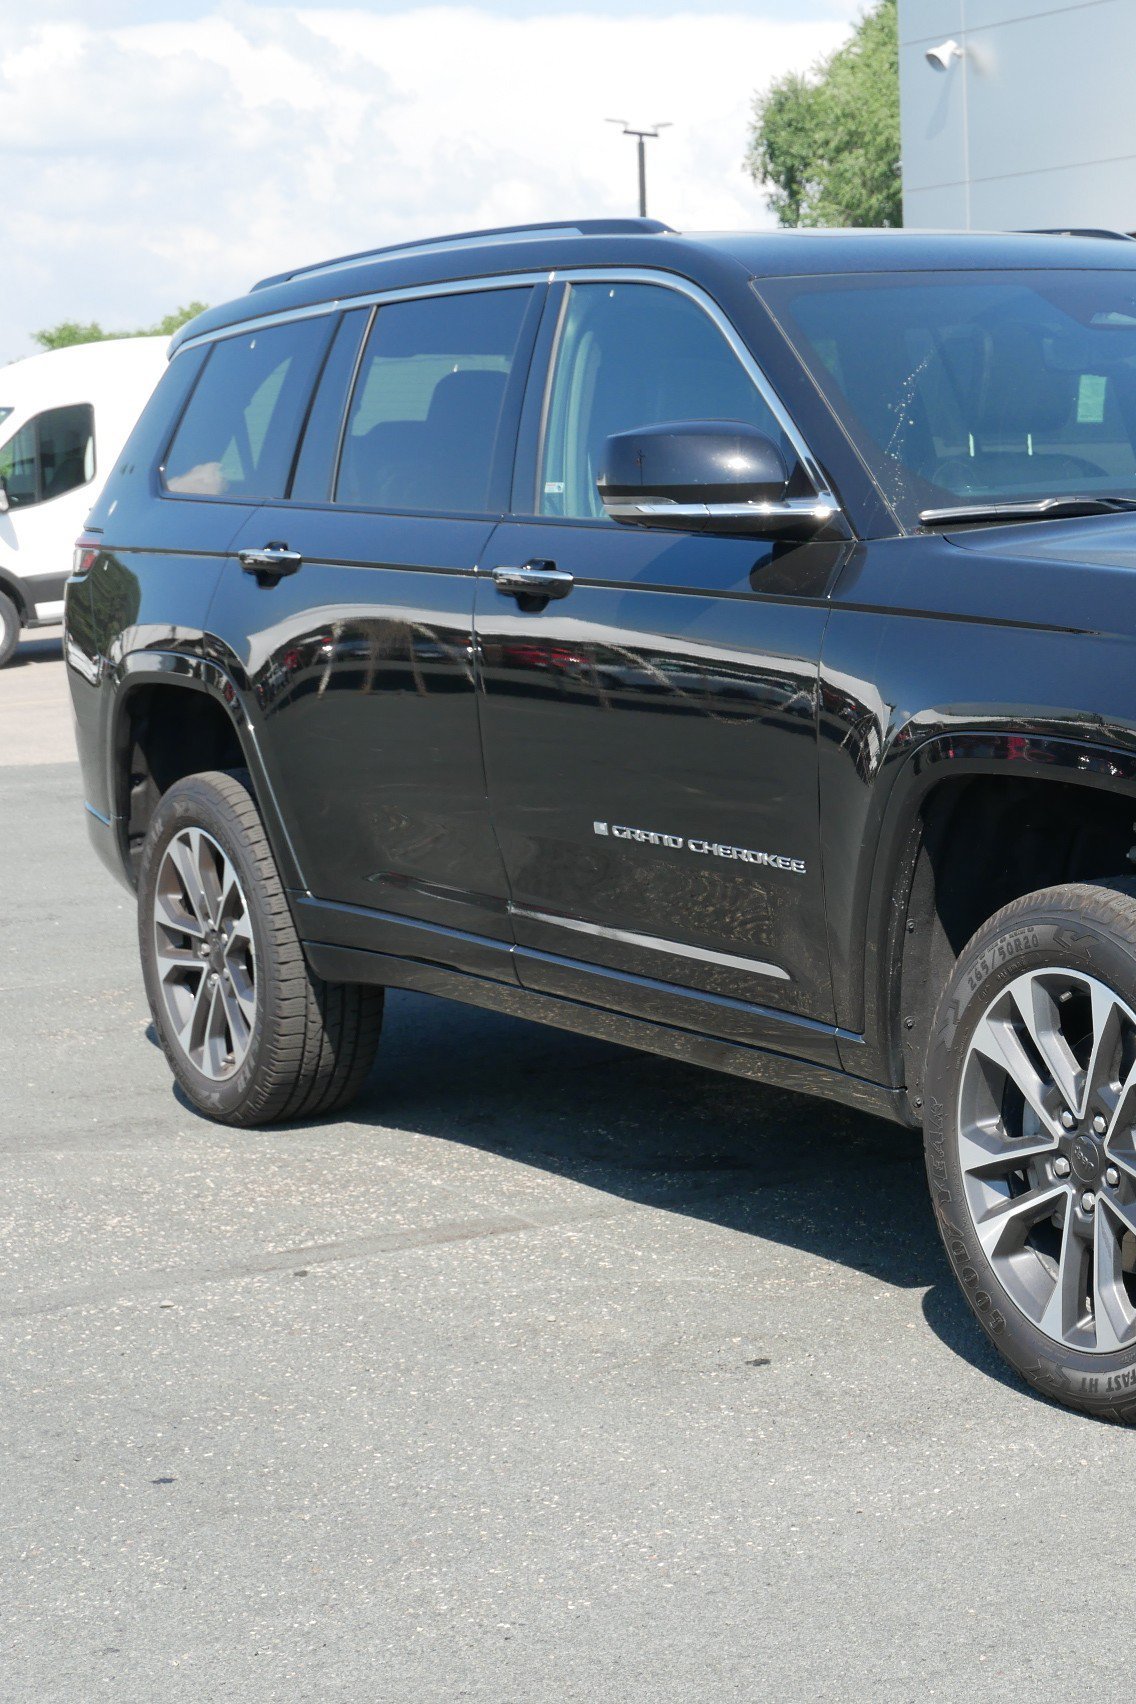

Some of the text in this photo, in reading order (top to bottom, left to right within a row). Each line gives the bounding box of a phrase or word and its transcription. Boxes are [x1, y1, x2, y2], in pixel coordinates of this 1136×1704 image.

[612, 825, 807, 874] GRAND CHEROKEE
[967, 933, 1041, 992] 265/50R20
[1080, 1377, 1099, 1393] HT
